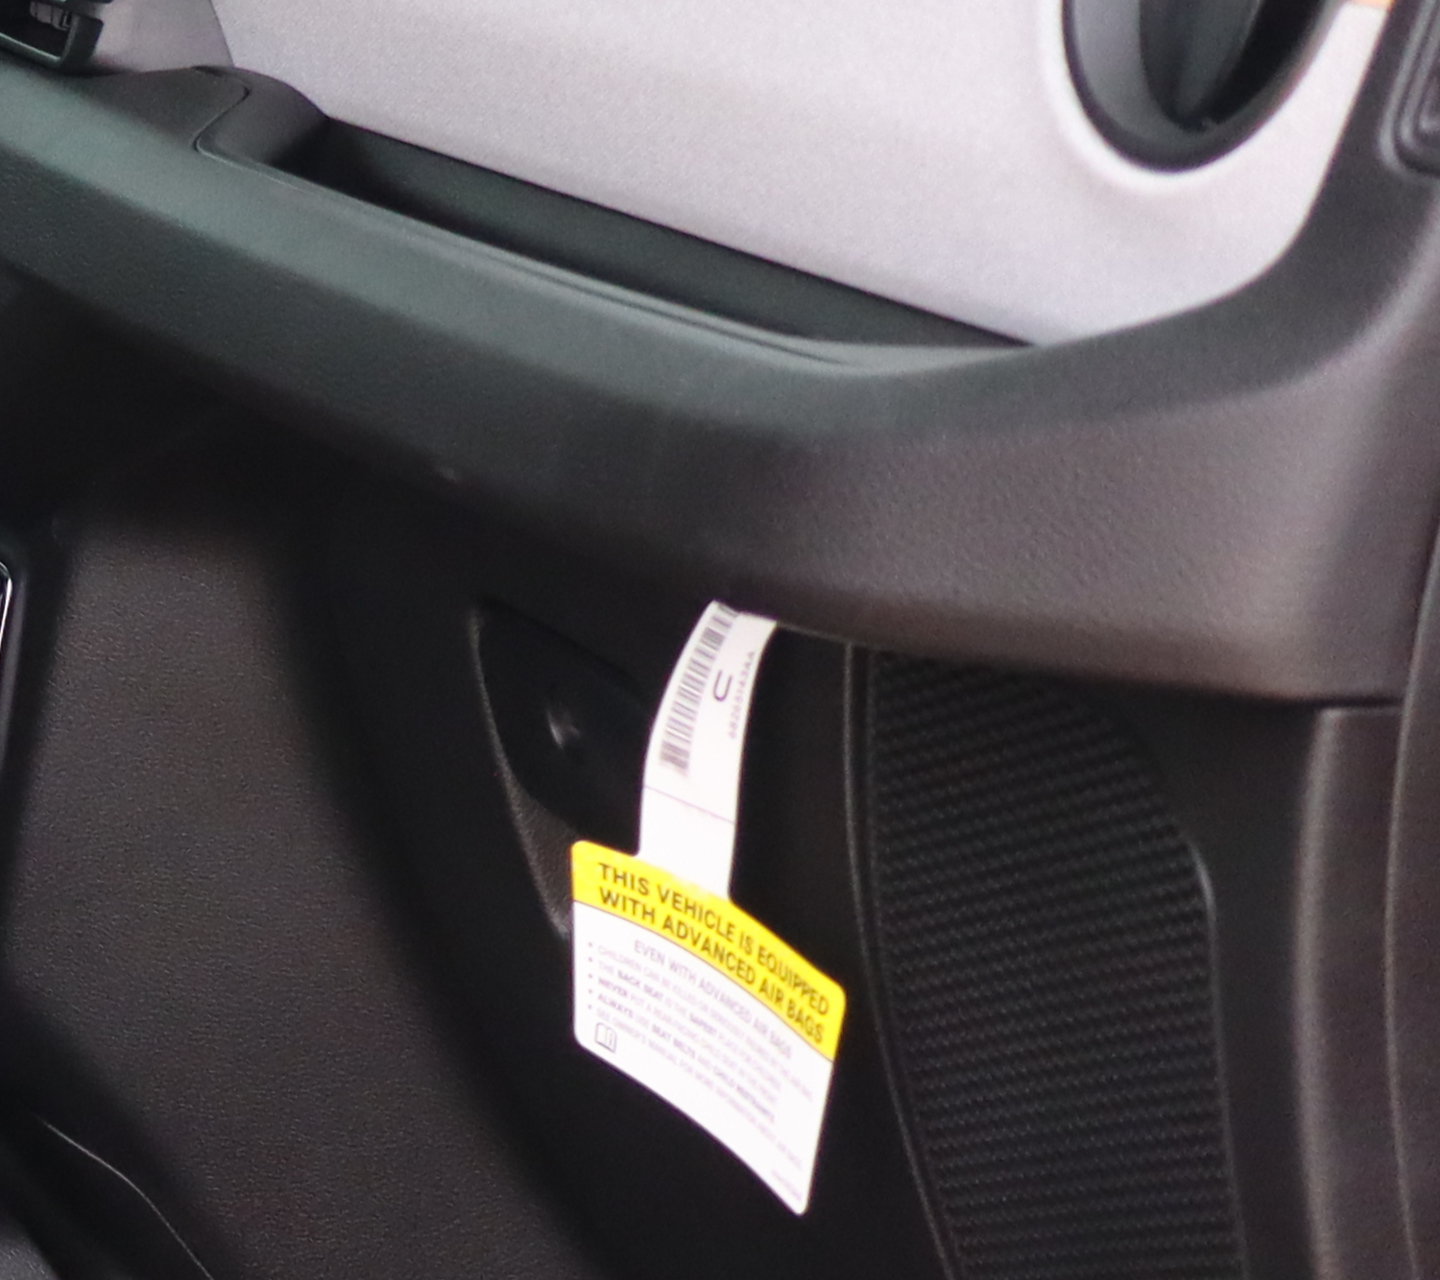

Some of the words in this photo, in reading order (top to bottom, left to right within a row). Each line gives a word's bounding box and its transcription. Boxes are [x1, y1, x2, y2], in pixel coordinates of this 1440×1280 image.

[597, 862, 650, 897] THIS
[656, 883, 736, 942] VEHICLE
[739, 934, 755, 956] IS
[757, 941, 830, 1017] EQUIPPED
[598, 886, 656, 924] WITH
[662, 913, 756, 986] ADVANCED
[758, 977, 785, 1009] AIR
[787, 999, 825, 1045] BAGS
[633, 939, 665, 966] EVEN
[669, 955, 698, 984] WITH
[698, 972, 753, 1024] ADVANCED
